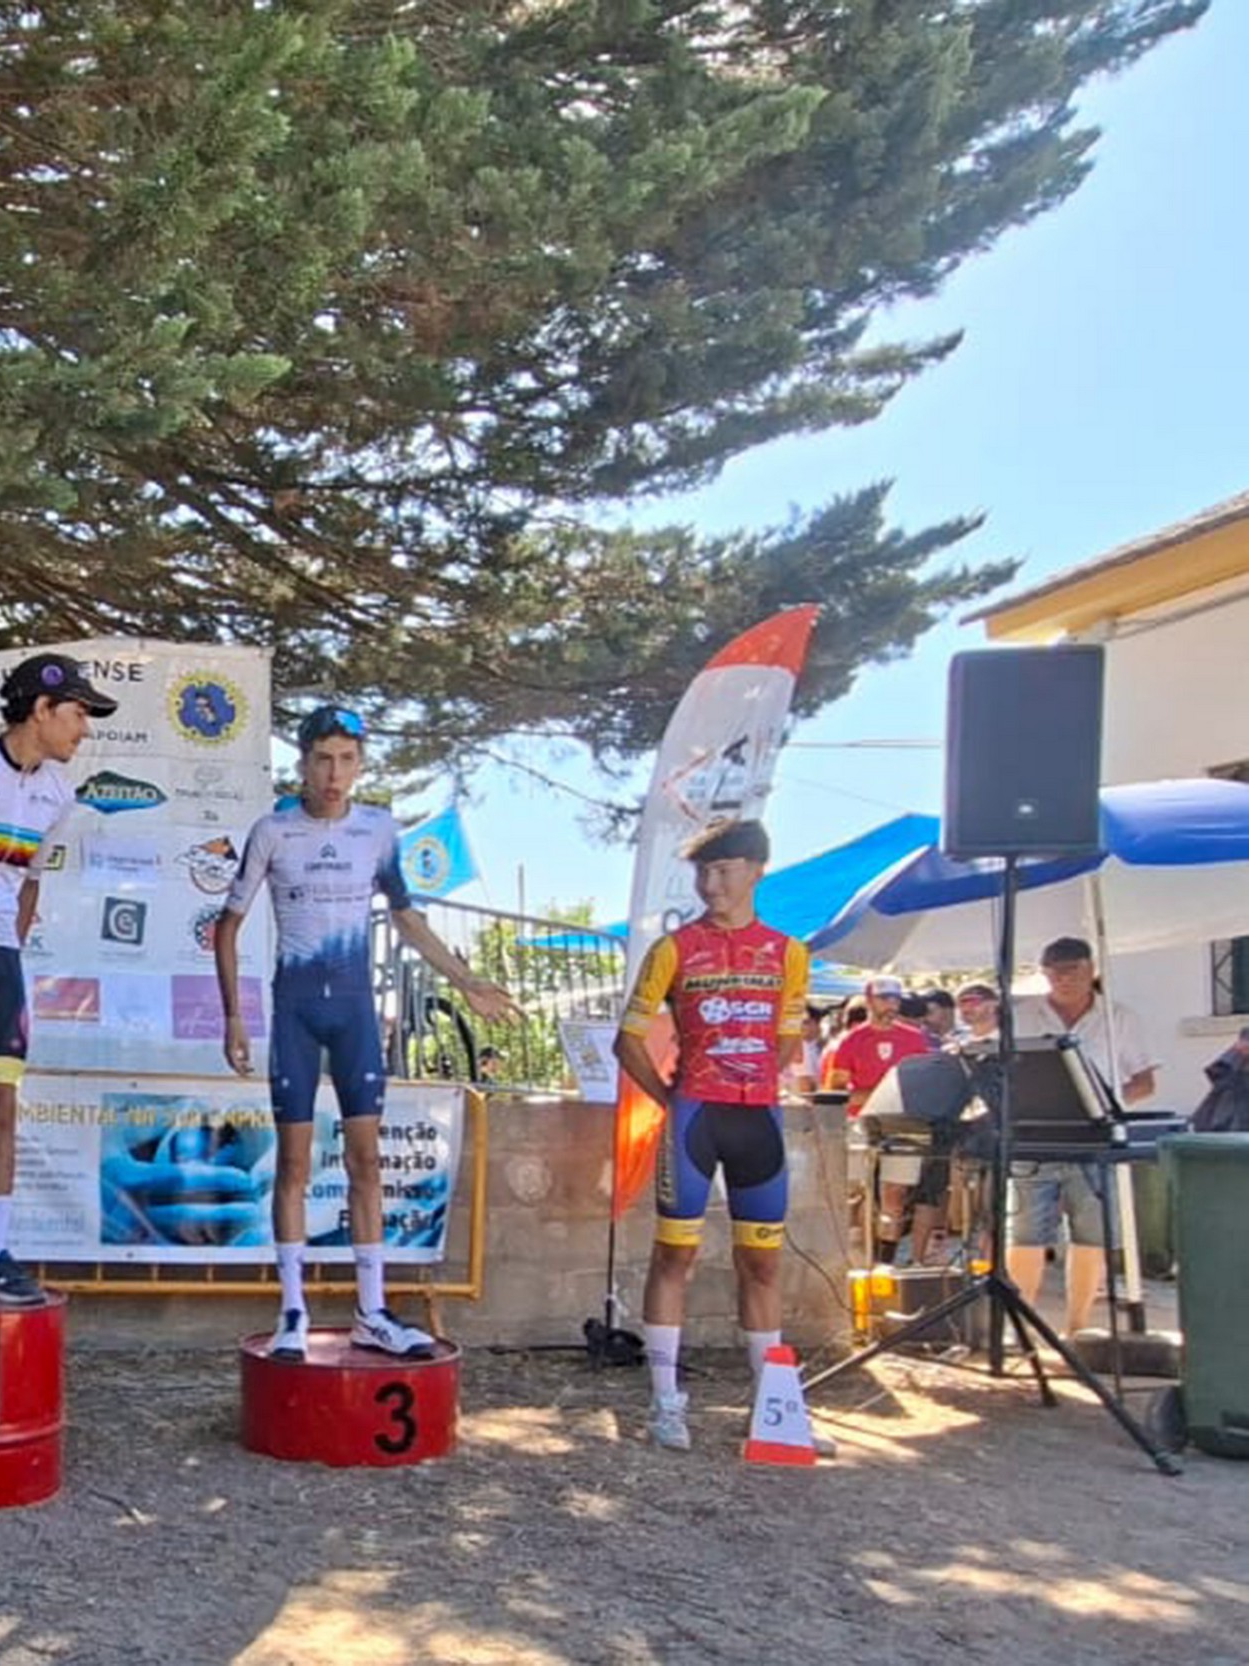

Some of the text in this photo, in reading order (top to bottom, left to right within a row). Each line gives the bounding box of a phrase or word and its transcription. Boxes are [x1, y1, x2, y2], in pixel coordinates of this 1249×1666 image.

[17, 1103, 118, 1125] MBIENTAL
[333, 1120, 438, 1145] Penção
[373, 1380, 417, 1456] 3
